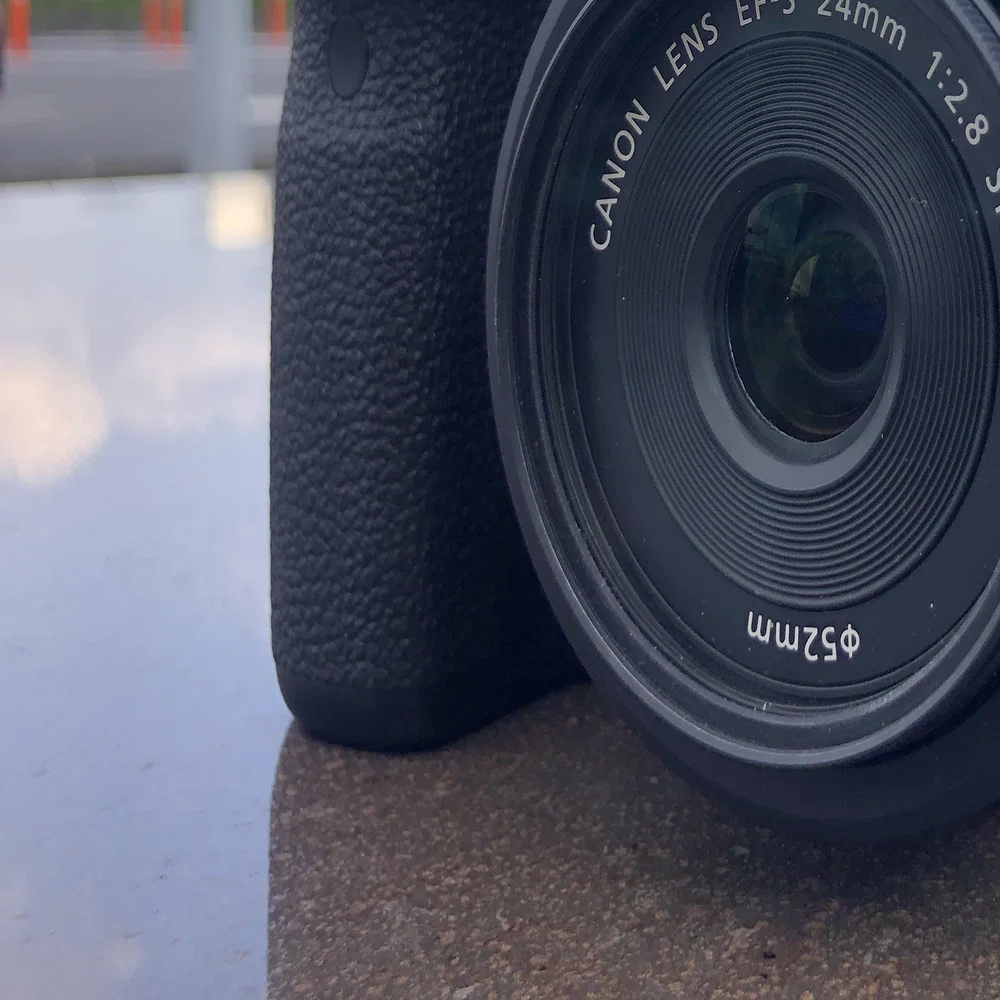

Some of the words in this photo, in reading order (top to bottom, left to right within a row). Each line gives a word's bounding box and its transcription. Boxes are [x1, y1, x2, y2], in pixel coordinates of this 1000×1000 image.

[590, 98, 651, 250] CANON
[653, 12, 719, 91] LENS
[926, 51, 989, 145] 1:2.8
